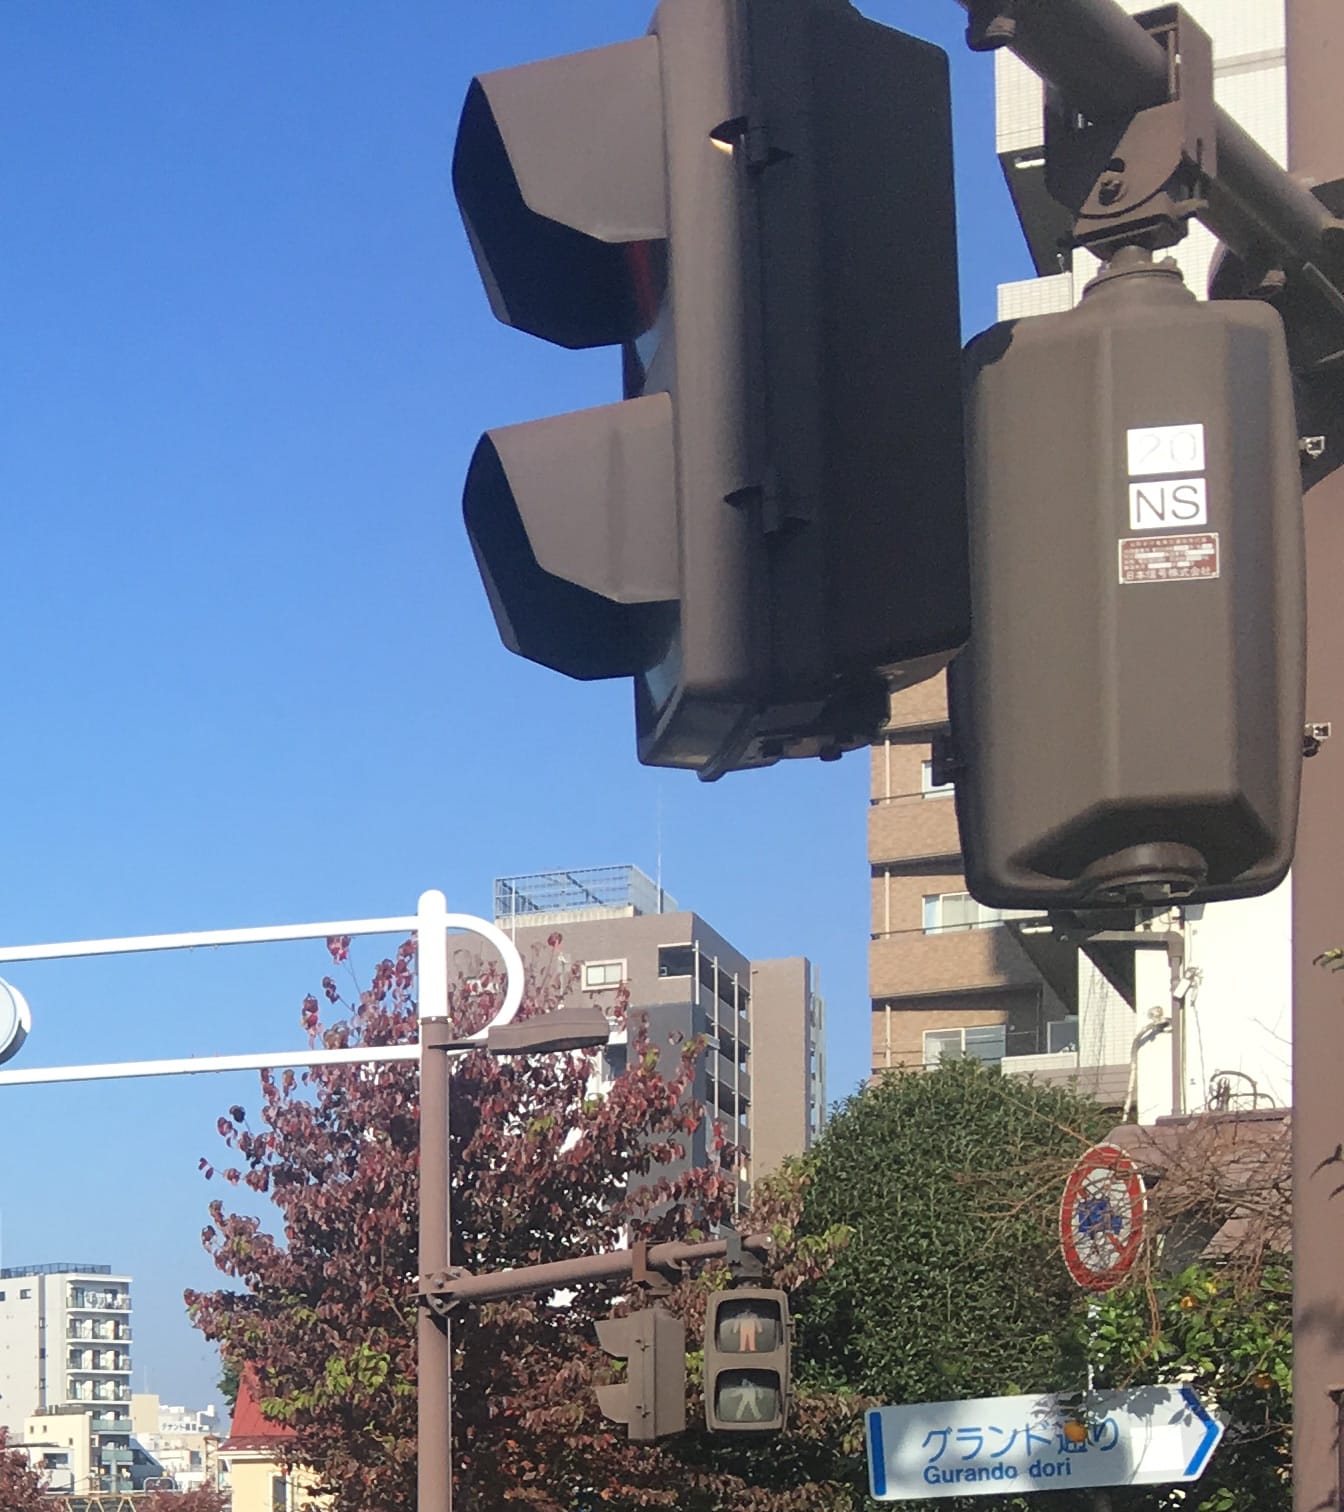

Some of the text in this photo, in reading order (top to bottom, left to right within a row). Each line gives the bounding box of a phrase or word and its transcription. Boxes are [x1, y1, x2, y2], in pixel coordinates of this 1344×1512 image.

[1136, 485, 1200, 523] NS
[923, 1457, 1072, 1484] Gurando dori
